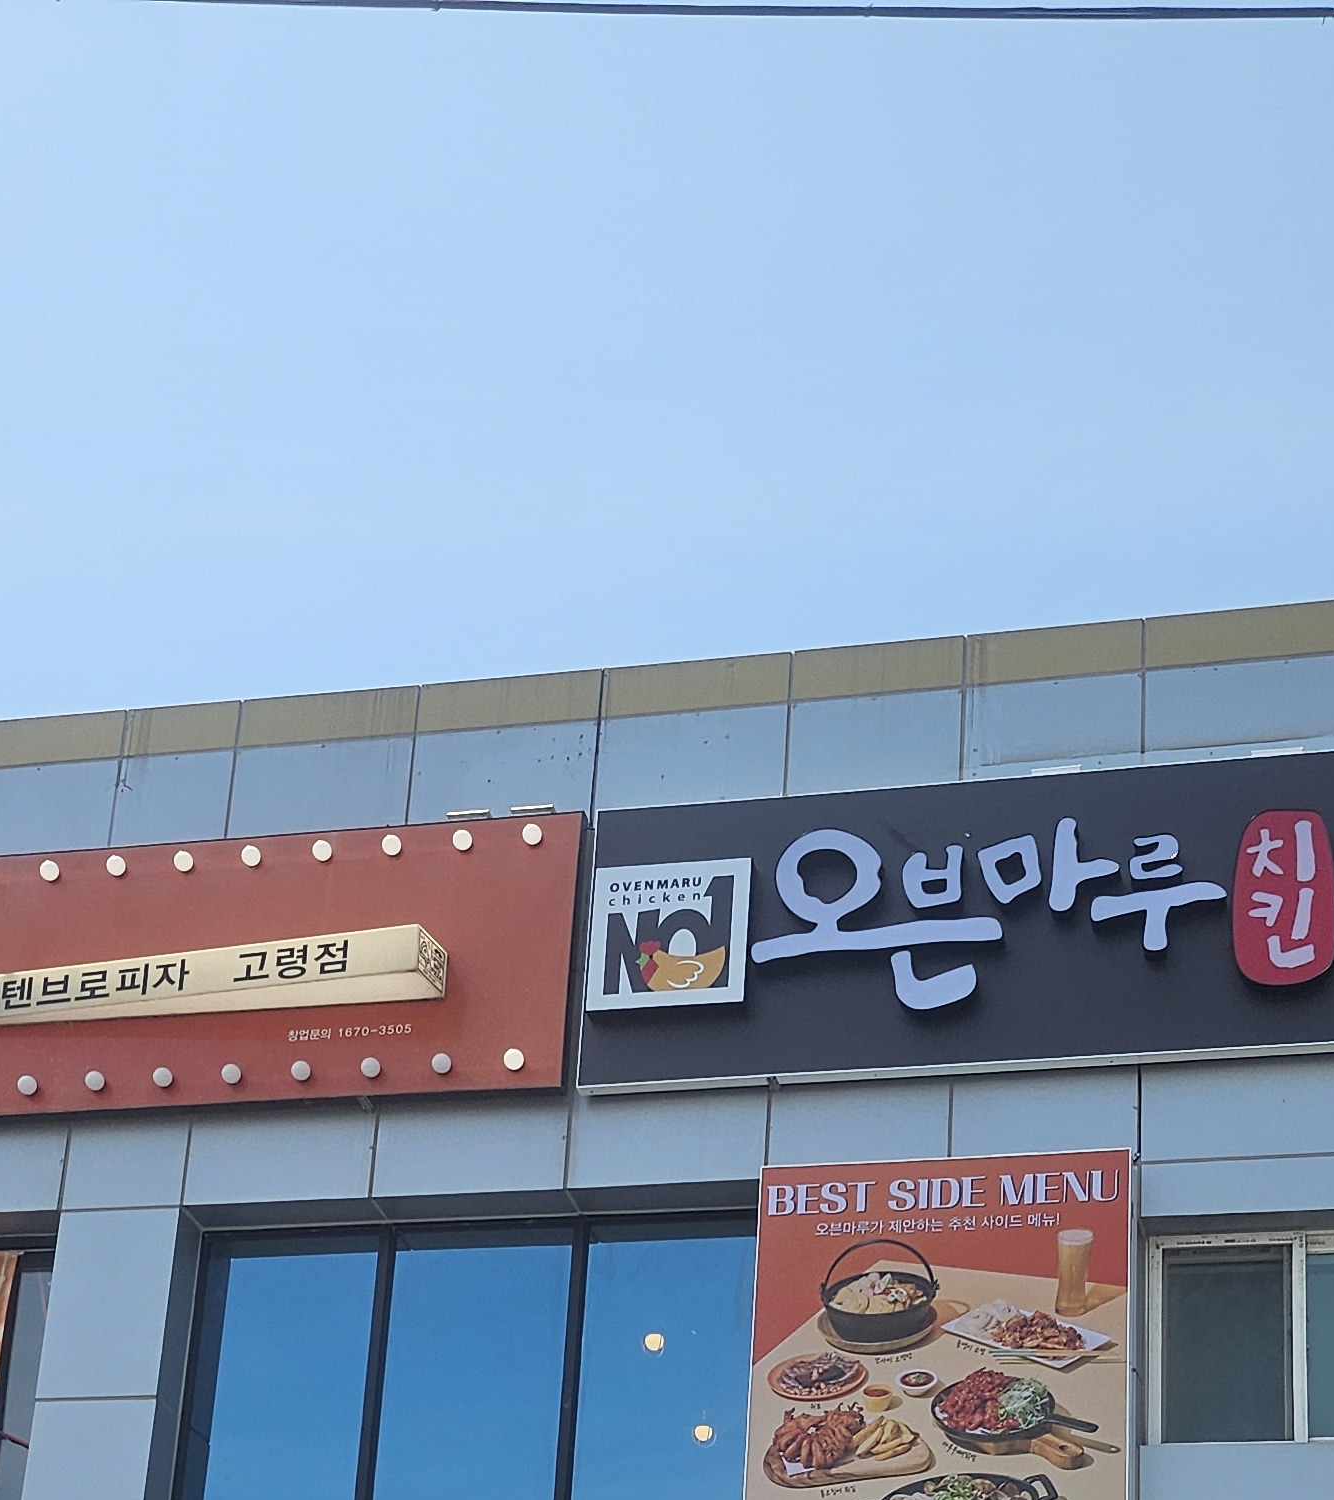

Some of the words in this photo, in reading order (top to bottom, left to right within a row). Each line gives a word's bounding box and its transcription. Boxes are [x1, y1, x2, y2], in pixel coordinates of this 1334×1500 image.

[609, 877, 702, 893] OVENMARU
[609, 892, 701, 906] chicken
[1246, 819, 1316, 971] 치킨
[752, 817, 1227, 1010] 오븐마루
[233, 939, 351, 986] 고령점
[287, 1026, 332, 1042] 창업문의
[337, 1023, 413, 1039] 1670-3505
[767, 1180, 877, 1217] BEST
[888, 1175, 986, 1212] SIDE
[999, 1169, 1120, 1207] MENU
[815, 1220, 885, 1237] 오븐마루가
[888, 1217, 944, 1234] 제안하는
[948, 1215, 977, 1231] 추천
[981, 1214, 1023, 1229] 사이드
[1028, 1212, 1061, 1227] 메뉴!
